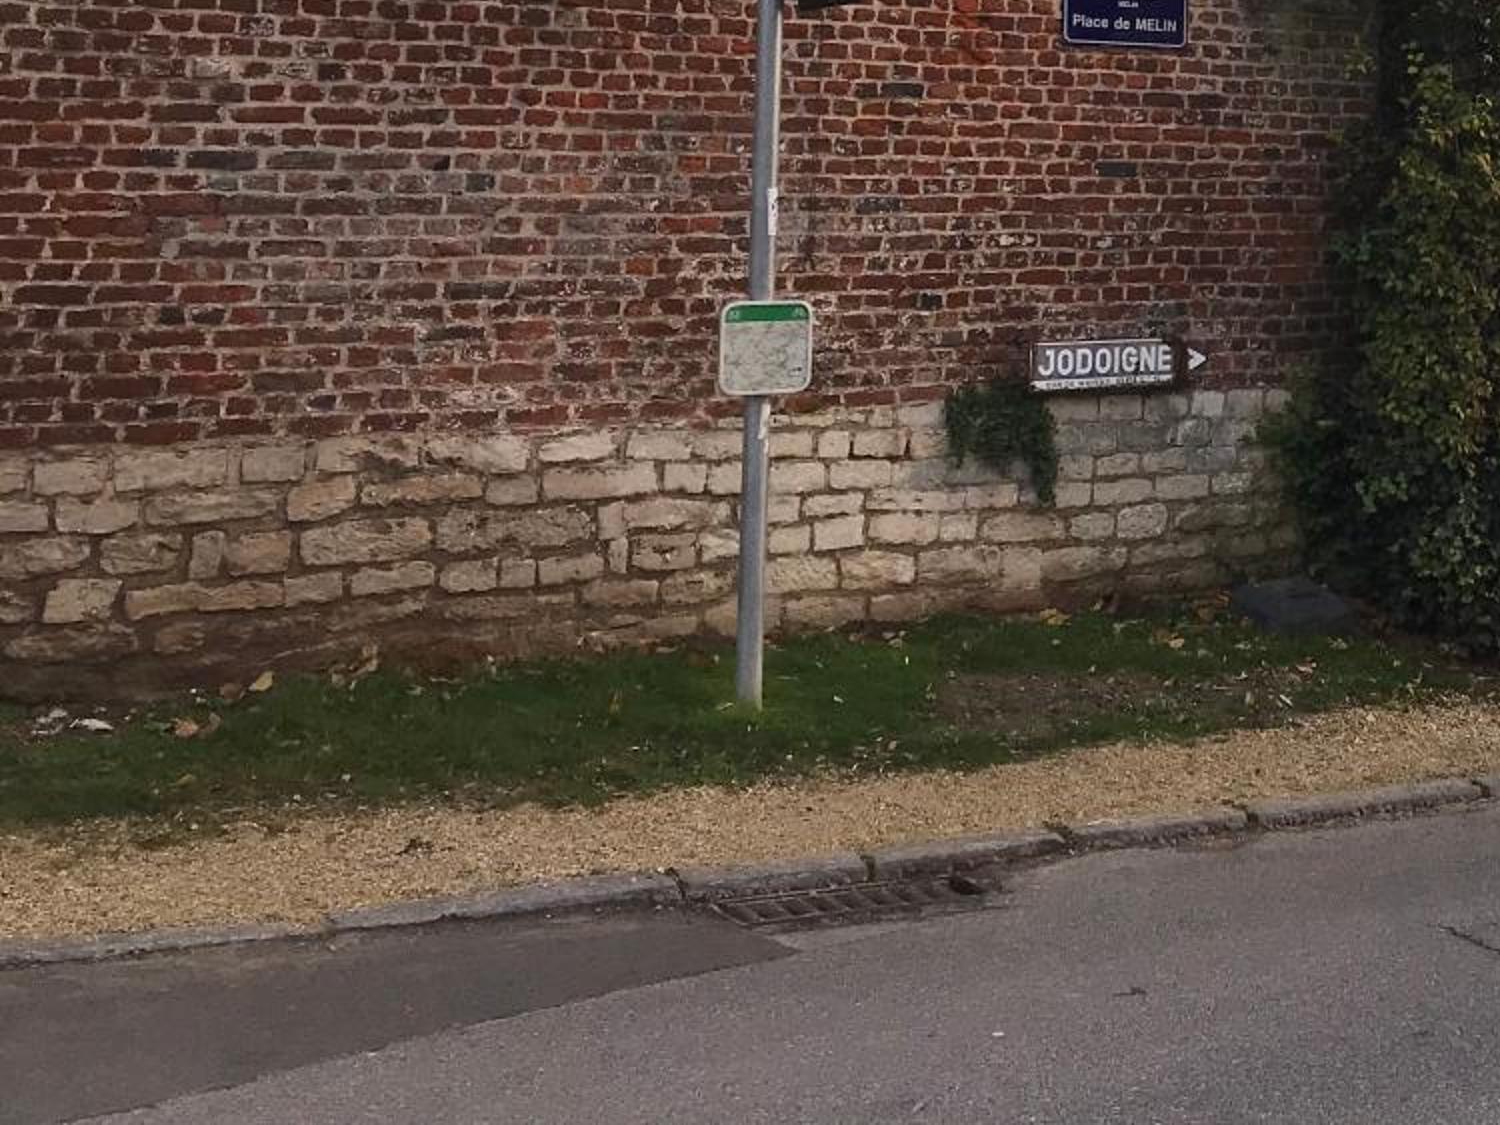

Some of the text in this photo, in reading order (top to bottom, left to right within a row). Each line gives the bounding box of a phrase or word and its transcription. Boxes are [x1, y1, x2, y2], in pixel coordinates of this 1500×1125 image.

[1072, 13, 1177, 32] Place de MELIN
[1037, 344, 1172, 376] JODOIGNE
